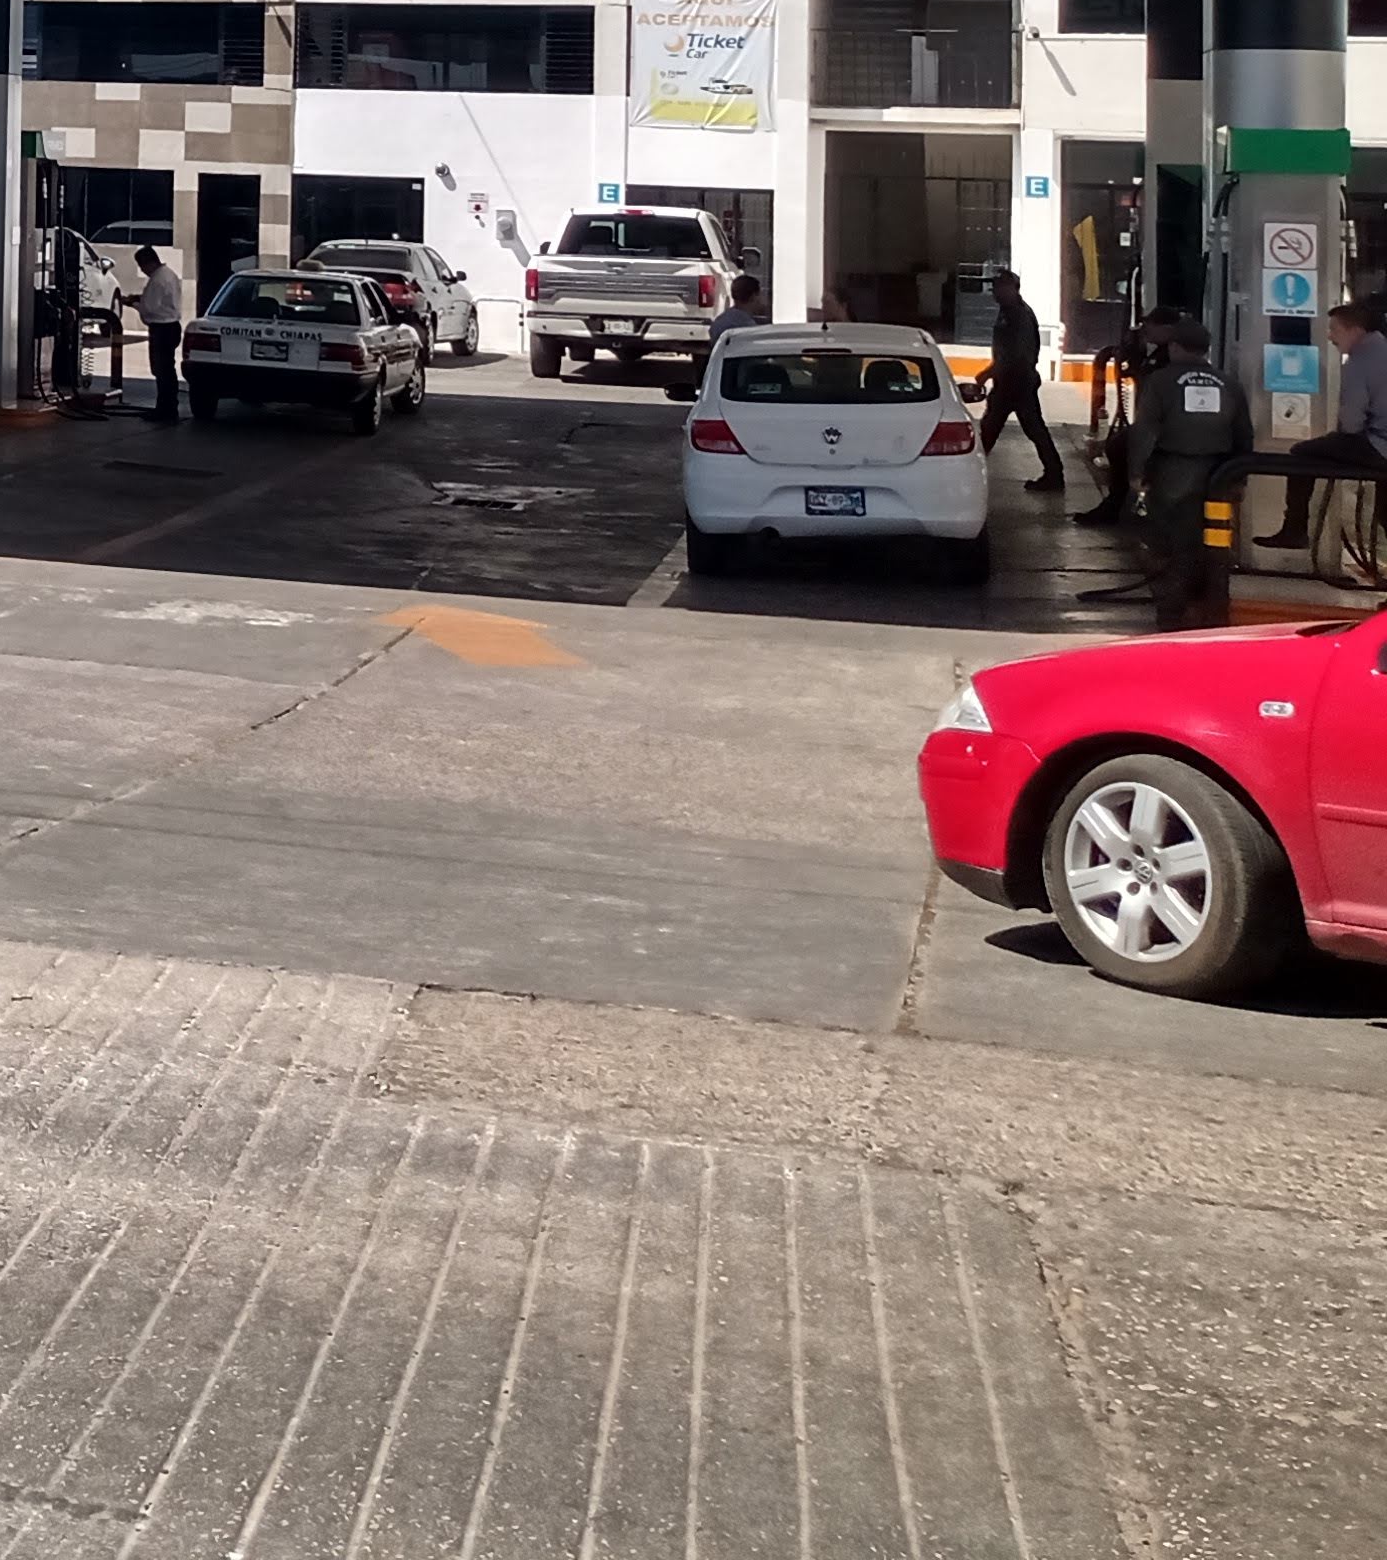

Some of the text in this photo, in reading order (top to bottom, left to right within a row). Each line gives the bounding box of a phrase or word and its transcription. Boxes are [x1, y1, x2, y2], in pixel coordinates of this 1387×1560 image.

[687, 33, 745, 49] Ticket
[686, 48, 708, 59] Car
[602, 185, 615, 201] E
[1030, 178, 1044, 195] E
[220, 327, 262, 338] COMITAN
[280, 330, 322, 341] CHIAPAS
